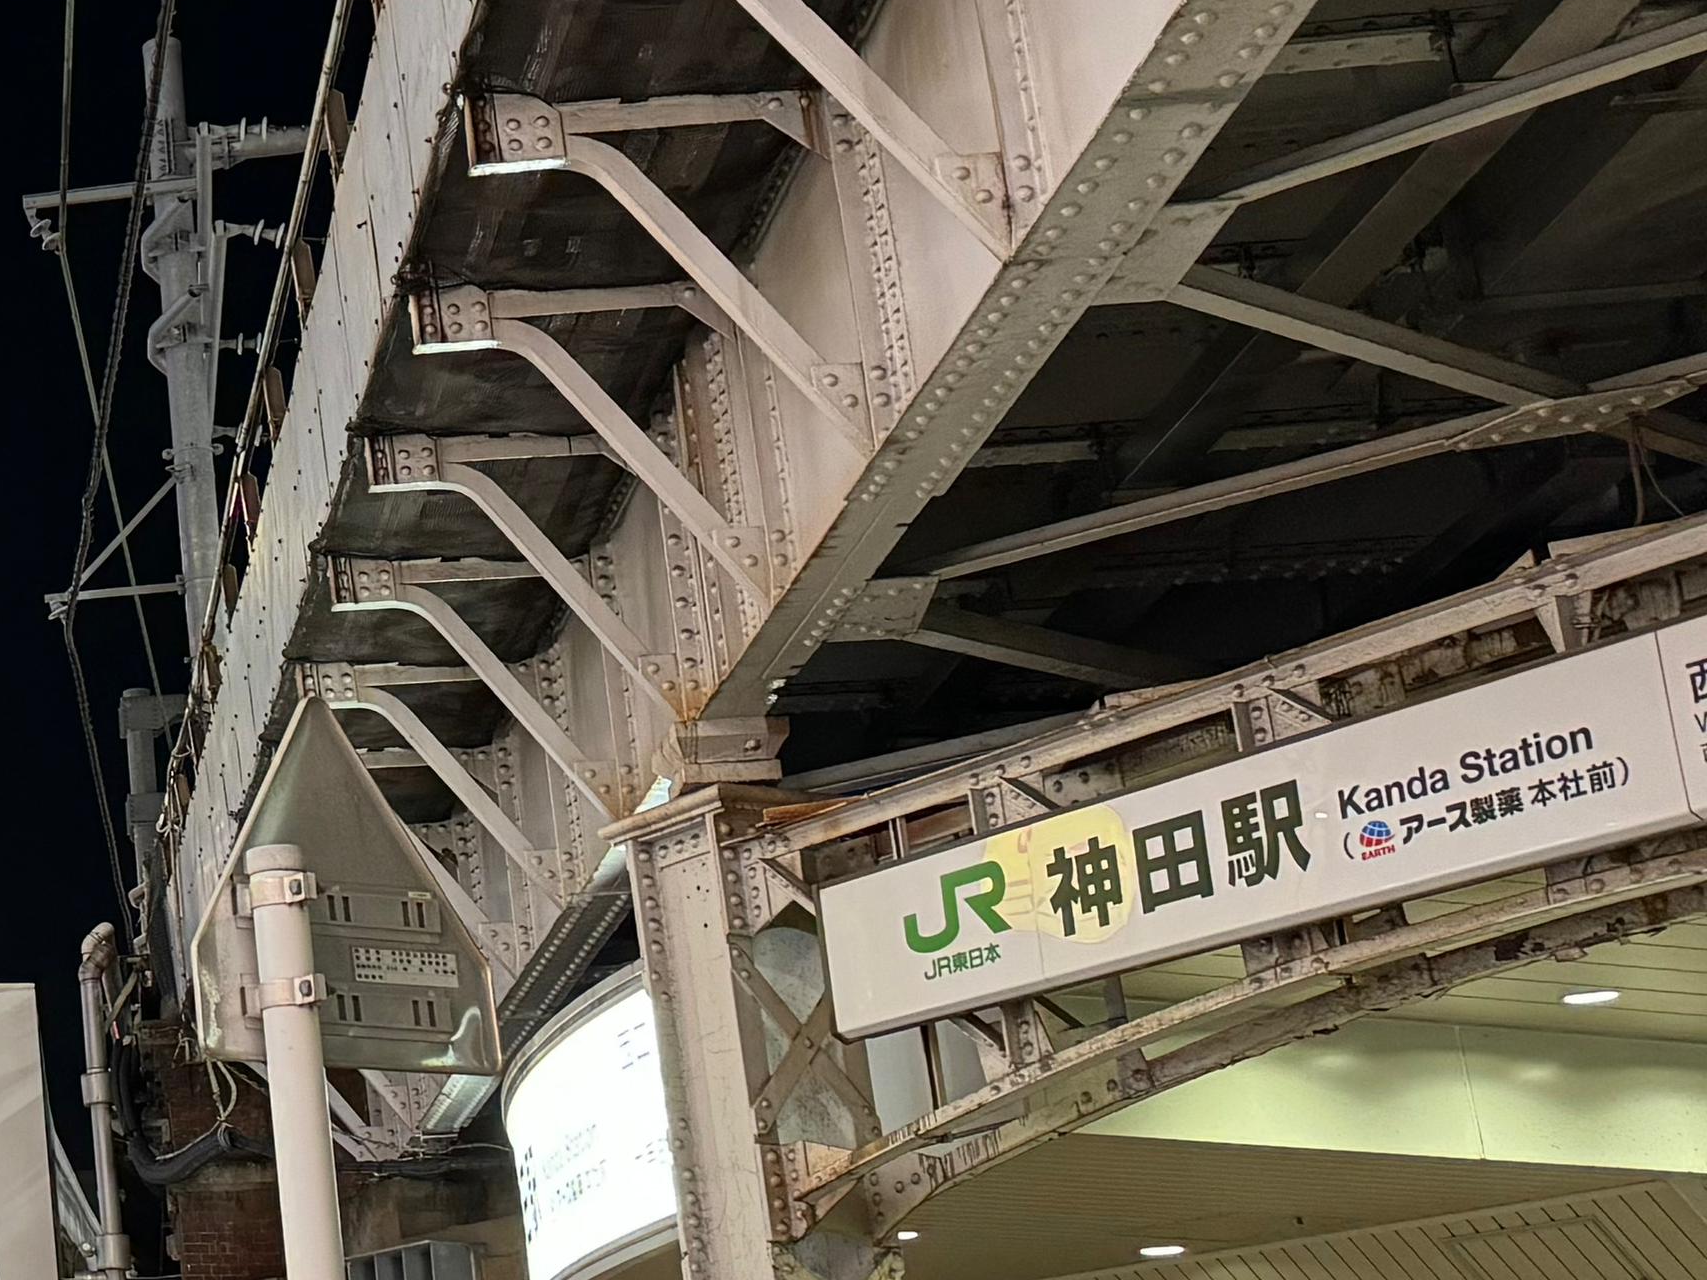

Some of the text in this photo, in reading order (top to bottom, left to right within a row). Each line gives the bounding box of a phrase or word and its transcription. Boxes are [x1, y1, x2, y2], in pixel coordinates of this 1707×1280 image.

[1337, 726, 1594, 819] Kanda Station
[1046, 777, 1311, 939] 神田駅
[1361, 845, 1396, 861] EARTH
[1398, 786, 1525, 845] アース製薬
[903, 860, 1012, 954] JR
[923, 943, 1002, 981] JR東日本
